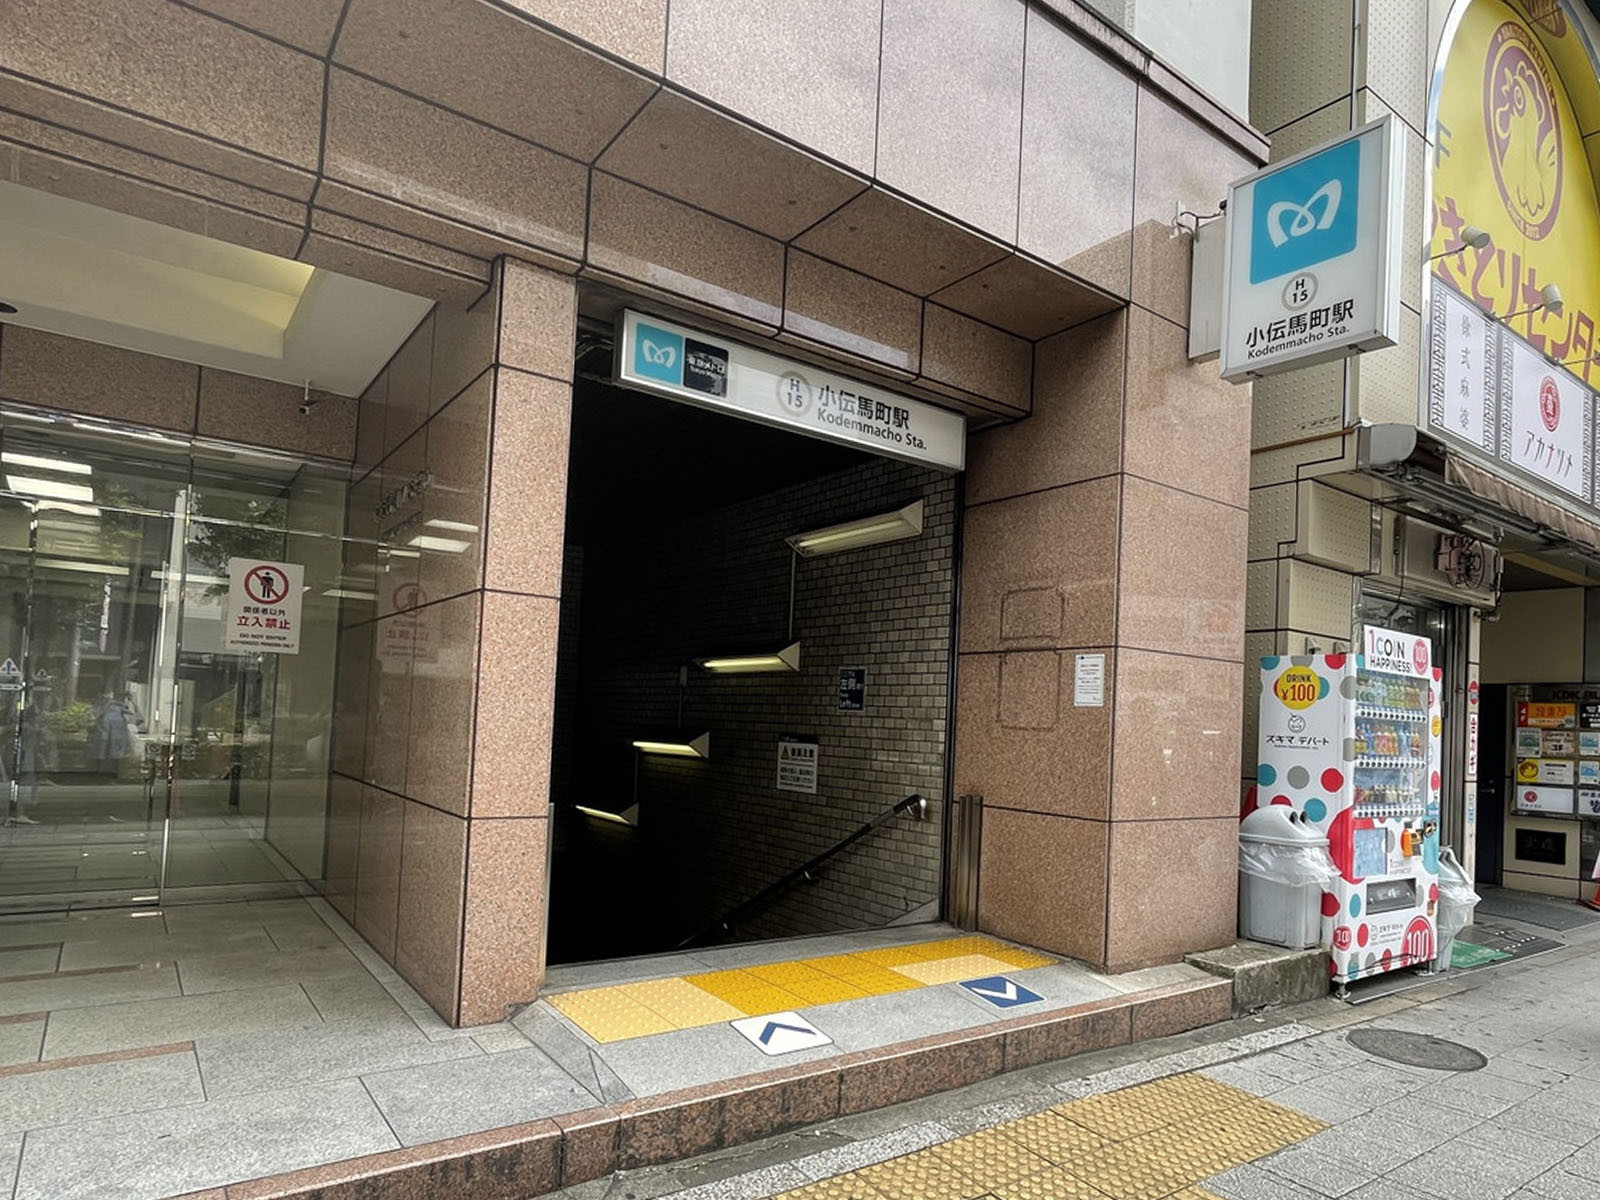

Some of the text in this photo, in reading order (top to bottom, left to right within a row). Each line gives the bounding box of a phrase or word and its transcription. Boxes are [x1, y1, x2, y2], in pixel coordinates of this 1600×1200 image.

[1295, 279, 1305, 290] H
[1293, 290, 1308, 304] 15
[1246, 299, 1354, 348] 小伝馬町駅
[1248, 325, 1350, 359] Kodemmacho Sta.
[790, 378, 800, 392] H
[787, 392, 803, 408] 15
[818, 385, 910, 430] 小伝馬町駅
[817, 408, 928, 450] Kodemmacho Sta.
[236, 615, 291, 630] 立入禁止
[1286, 674, 1312, 683] DRINK
[1266, 735, 1295, 744] スキマ
